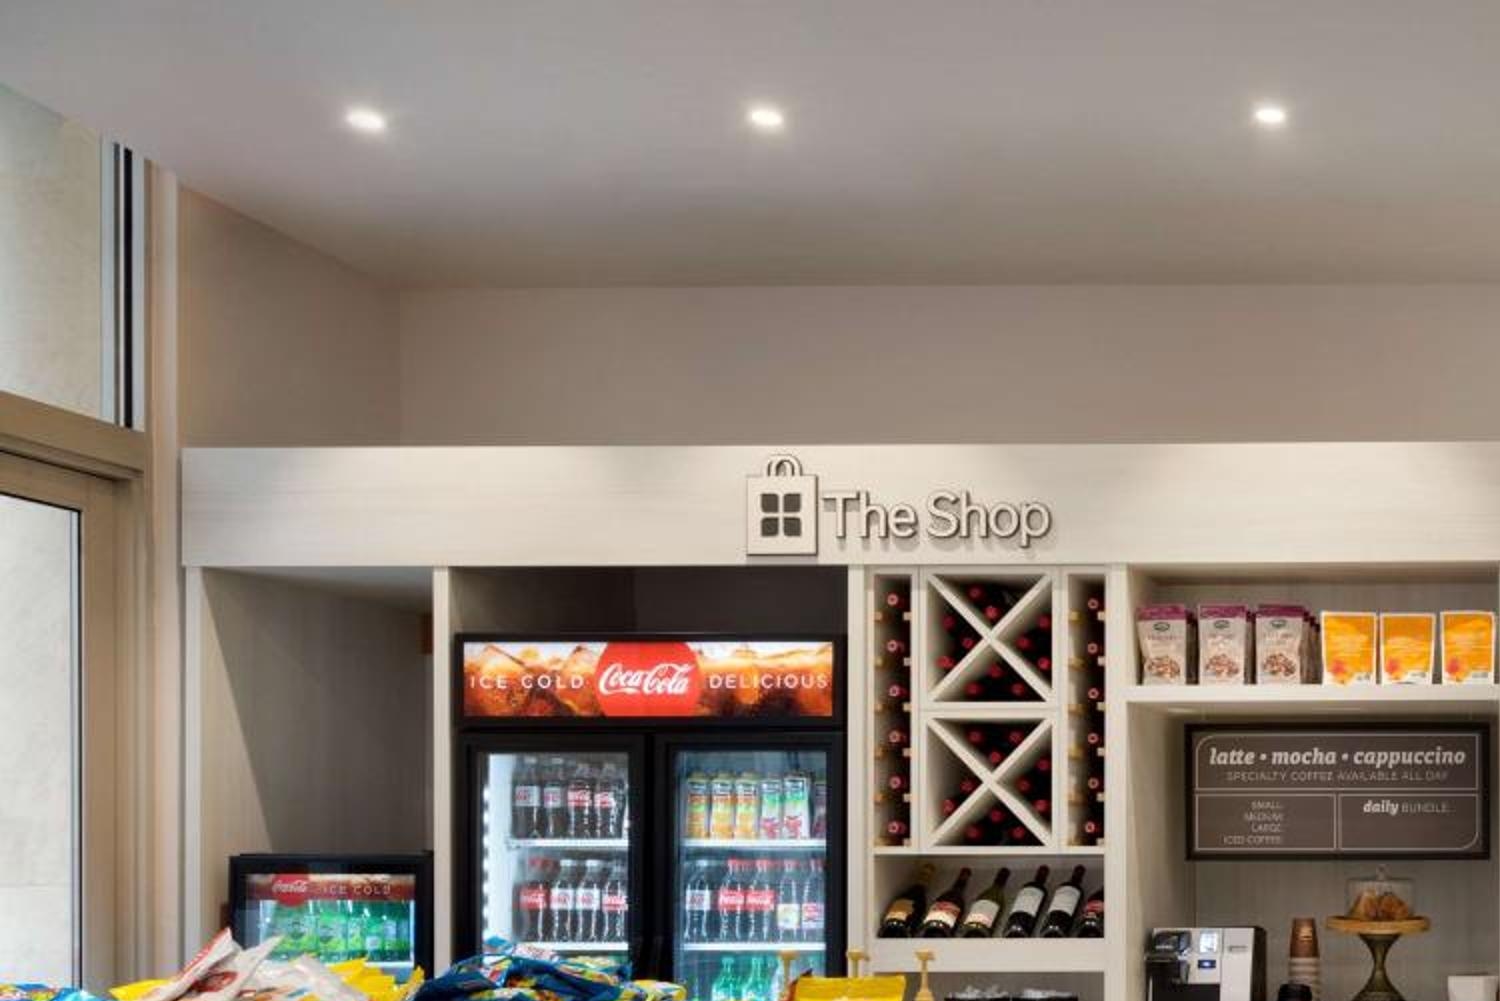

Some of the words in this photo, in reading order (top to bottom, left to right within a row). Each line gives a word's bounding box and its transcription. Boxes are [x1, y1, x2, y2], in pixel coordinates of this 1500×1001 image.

[822, 490, 918, 540] The
[926, 490, 1053, 549] Shop
[469, 675, 508, 690] ICE
[521, 675, 585, 690] COLD
[599, 662, 694, 696] Coca-Cola
[708, 673, 830, 690] DELICIOUS
[1208, 747, 1256, 766] latte
[1270, 747, 1337, 766] mocha
[1352, 745, 1466, 770] cappuccino
[1226, 771, 1287, 782] SPECIALTY
[1291, 771, 1334, 781] COFFEE
[1338, 771, 1398, 781] AVAILABLE
[1362, 799, 1399, 815] daily
